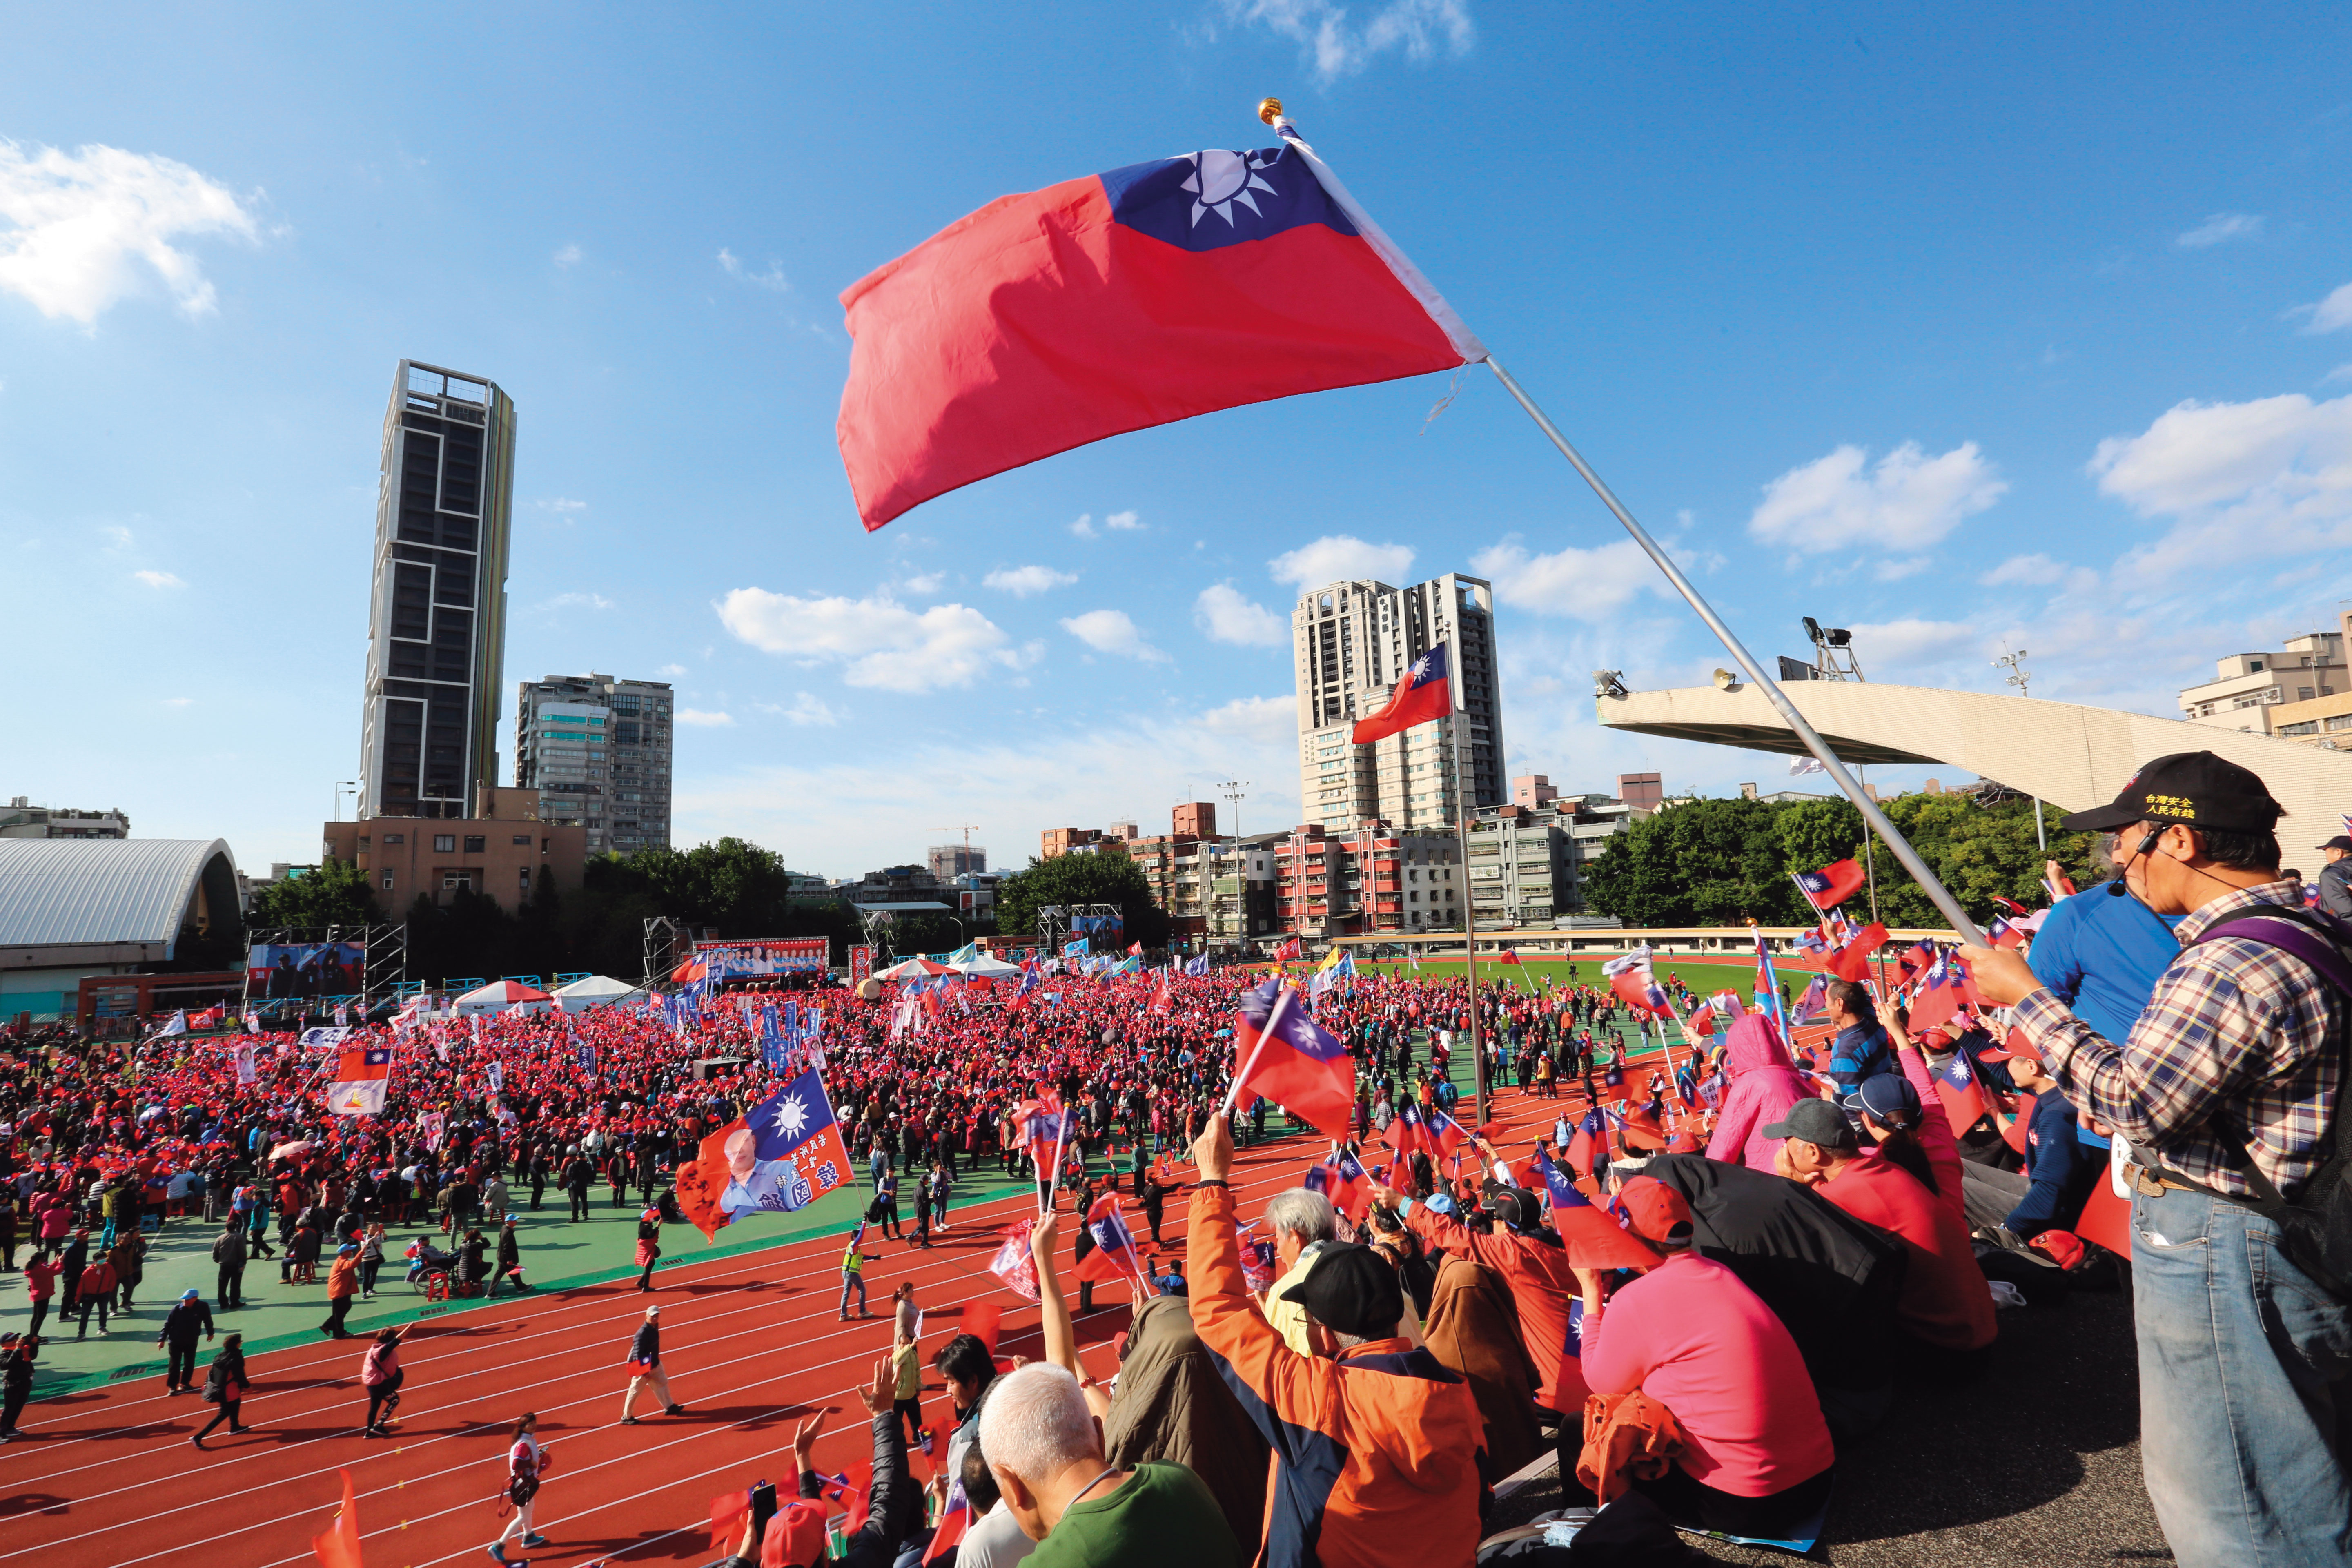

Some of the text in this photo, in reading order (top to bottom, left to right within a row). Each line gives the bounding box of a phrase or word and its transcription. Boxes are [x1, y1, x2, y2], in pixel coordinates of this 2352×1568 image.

[2145, 793, 2193, 808] 台灣安全
[2146, 804, 2196, 819] 人民有錢
